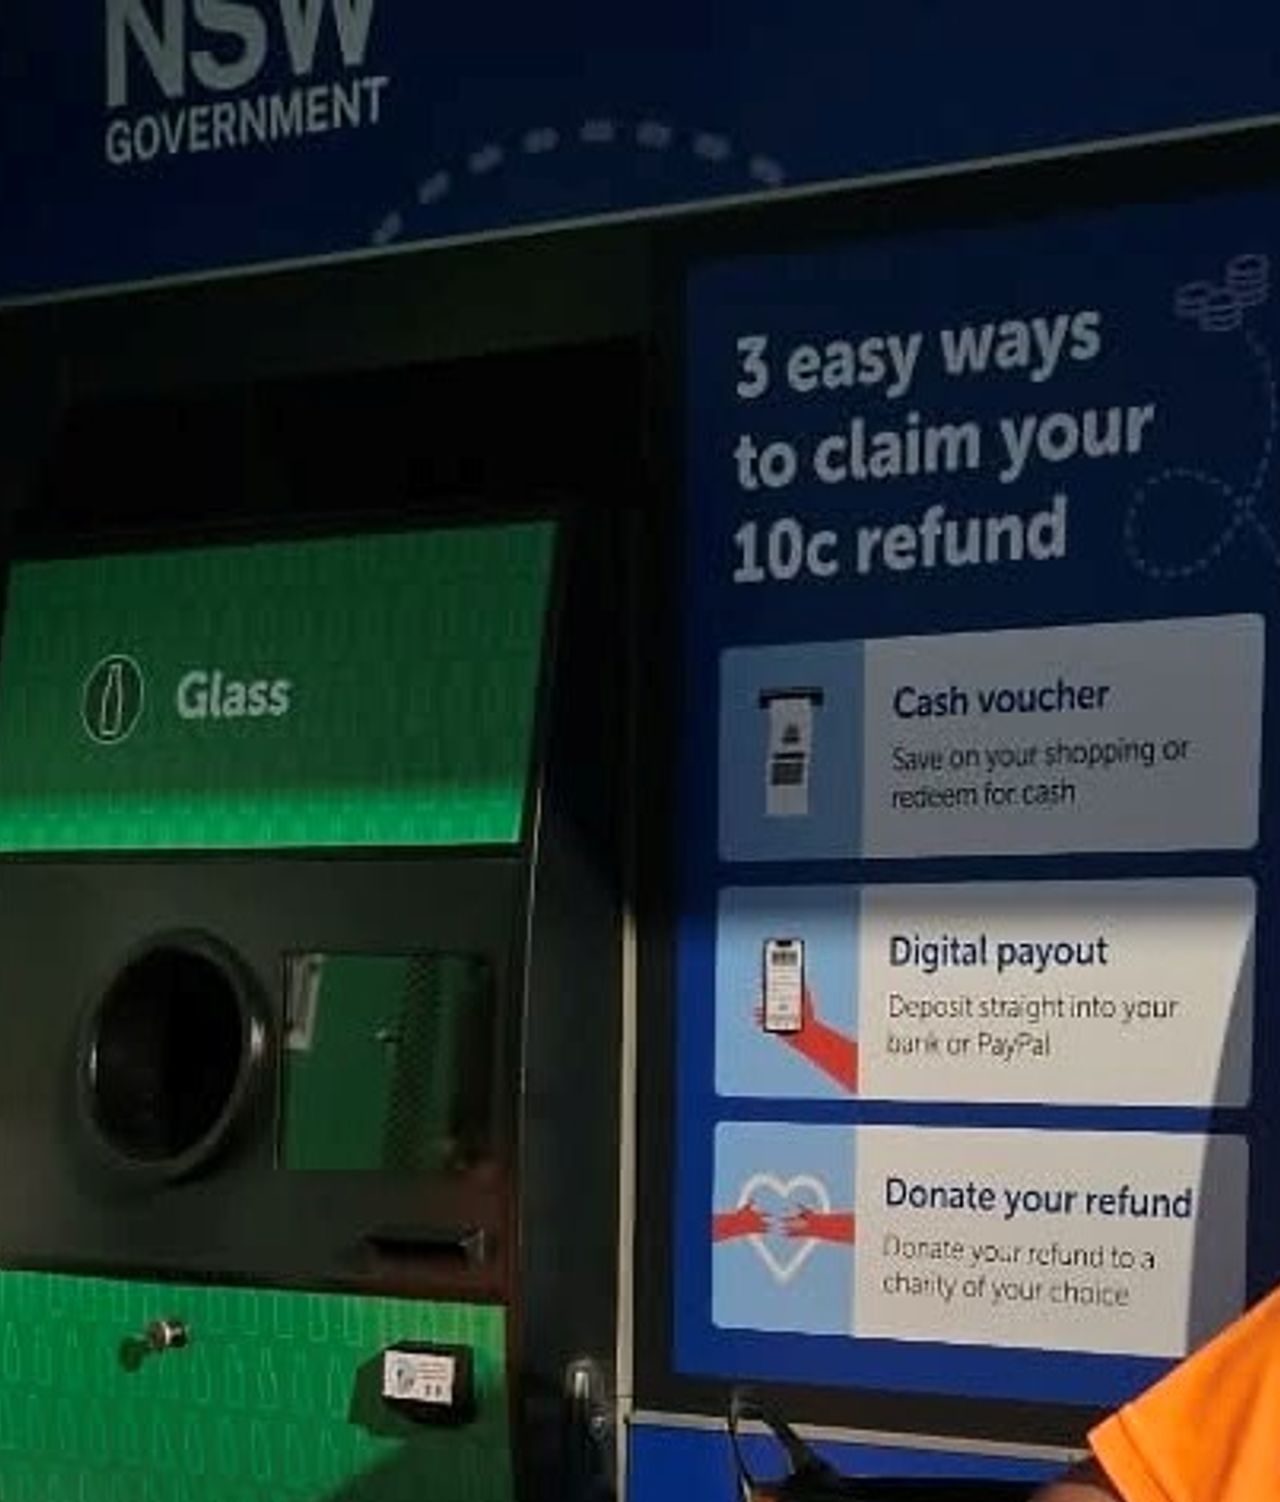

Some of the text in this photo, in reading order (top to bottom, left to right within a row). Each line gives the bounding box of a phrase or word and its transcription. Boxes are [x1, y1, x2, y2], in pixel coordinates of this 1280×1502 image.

[104, 75, 391, 166] GOVERNMENT
[735, 309, 1103, 399] 3 easy ways
[732, 402, 1156, 492] to claim your
[732, 492, 1066, 584] 10c refund
[178, 669, 294, 719] Glass
[893, 677, 1110, 718] Cash voucher
[892, 738, 1190, 773] Save on your shopping or
[892, 779, 1075, 809] redeem for cash
[888, 934, 1109, 973] Digital payout
[888, 994, 1179, 1024] Deposit straight into your
[887, 1031, 1050, 1061] bank or PayPal
[886, 1178, 1193, 1219] Donate your refund
[883, 1234, 1155, 1269] Donate your refund to a
[883, 1273, 1129, 1307] charity of your choice
